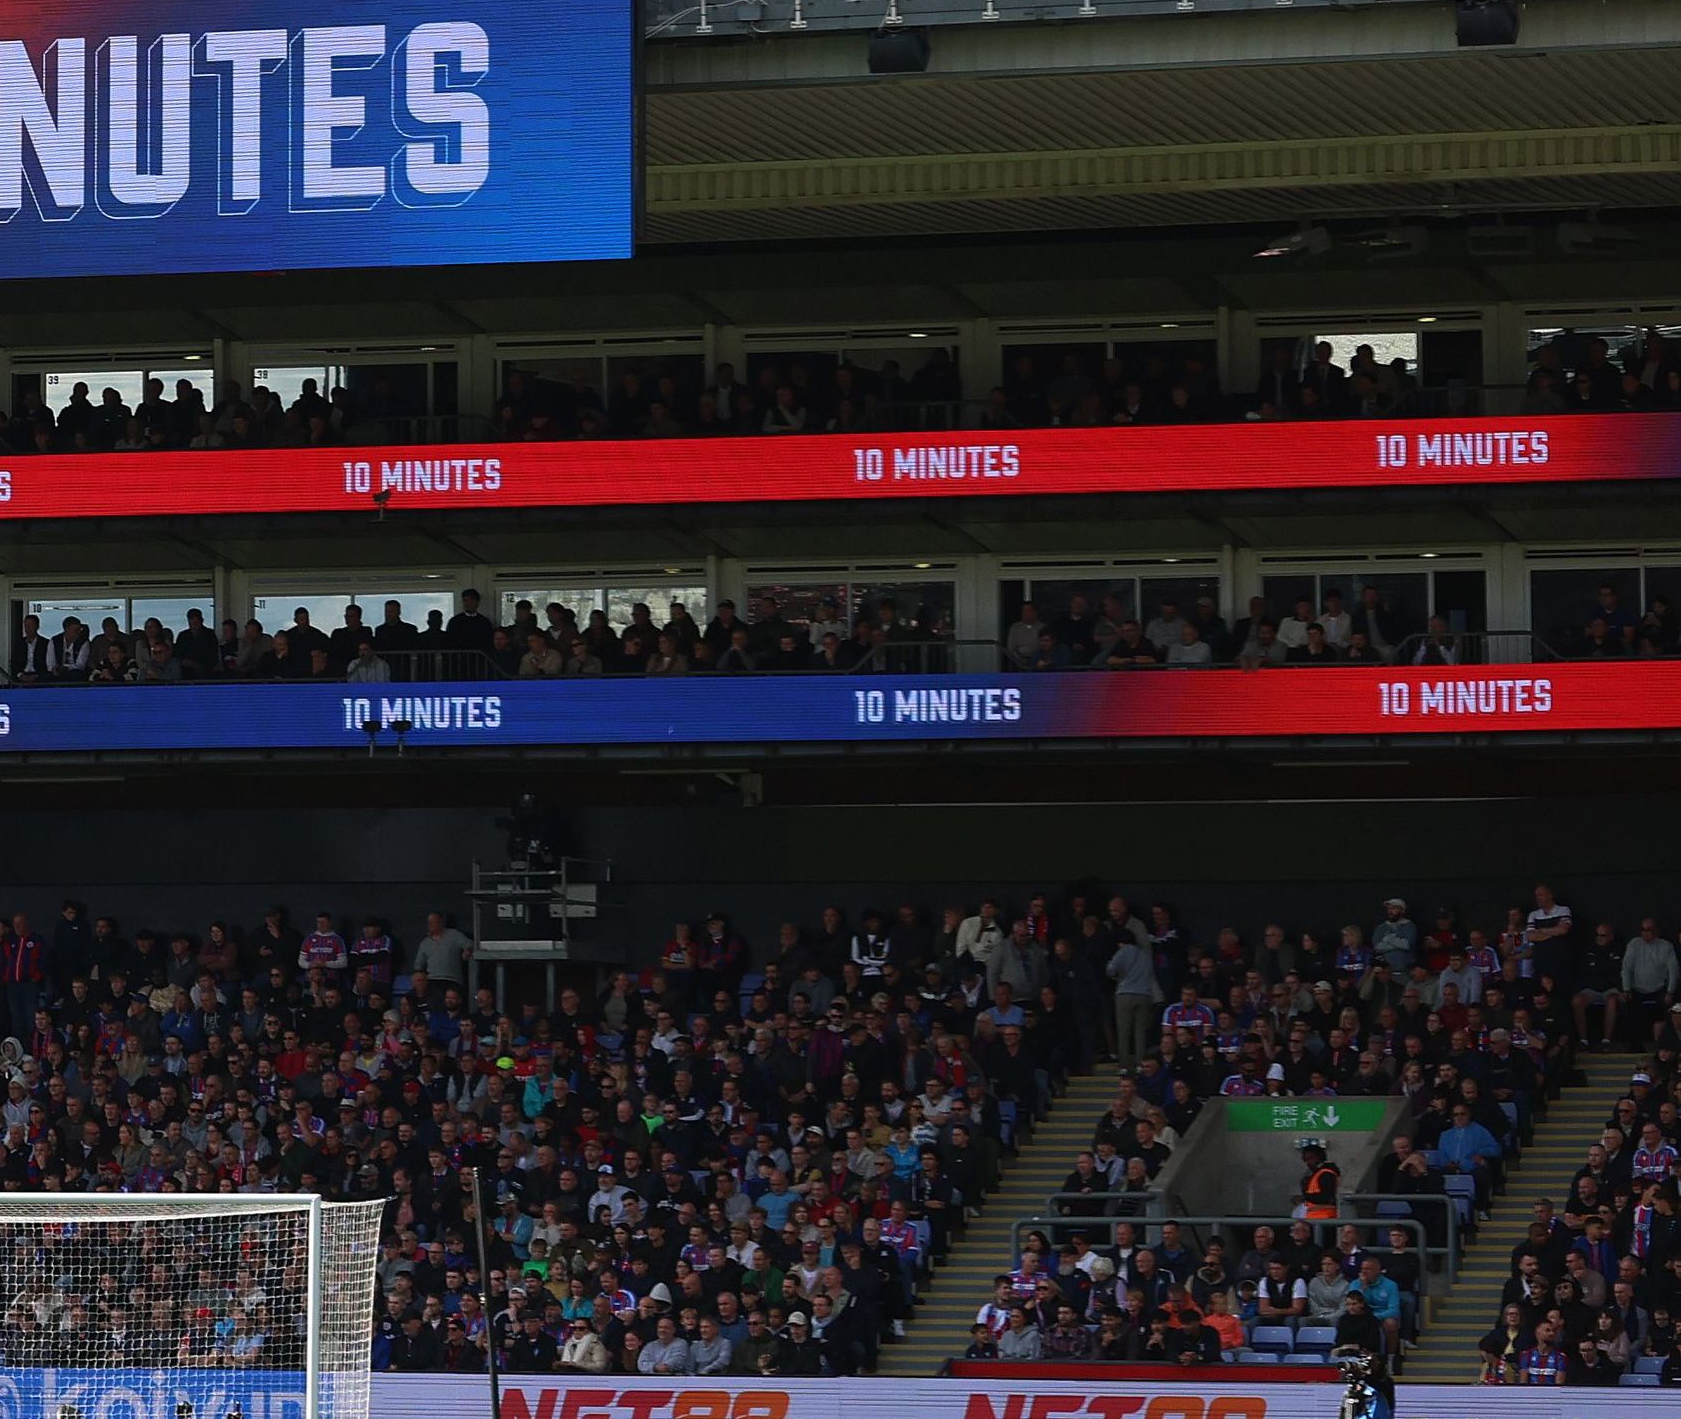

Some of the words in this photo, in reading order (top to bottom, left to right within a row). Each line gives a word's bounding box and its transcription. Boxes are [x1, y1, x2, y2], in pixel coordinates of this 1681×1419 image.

[854, 448, 883, 482] 10
[894, 445, 1019, 481] MINUTES
[1376, 435, 1407, 468] 10
[1417, 431, 1549, 468] MINUTES
[343, 462, 371, 494] 10
[381, 458, 501, 493] MINUTES
[343, 698, 371, 730] 10
[381, 696, 501, 730] MINUTES
[855, 690, 884, 724] 10
[895, 688, 1021, 723] MINUTES
[1379, 682, 1409, 716] 10
[1420, 679, 1552, 715] MINUTES
[1273, 1105, 1299, 1116] FIRE
[1273, 1118, 1298, 1128] EXIT
